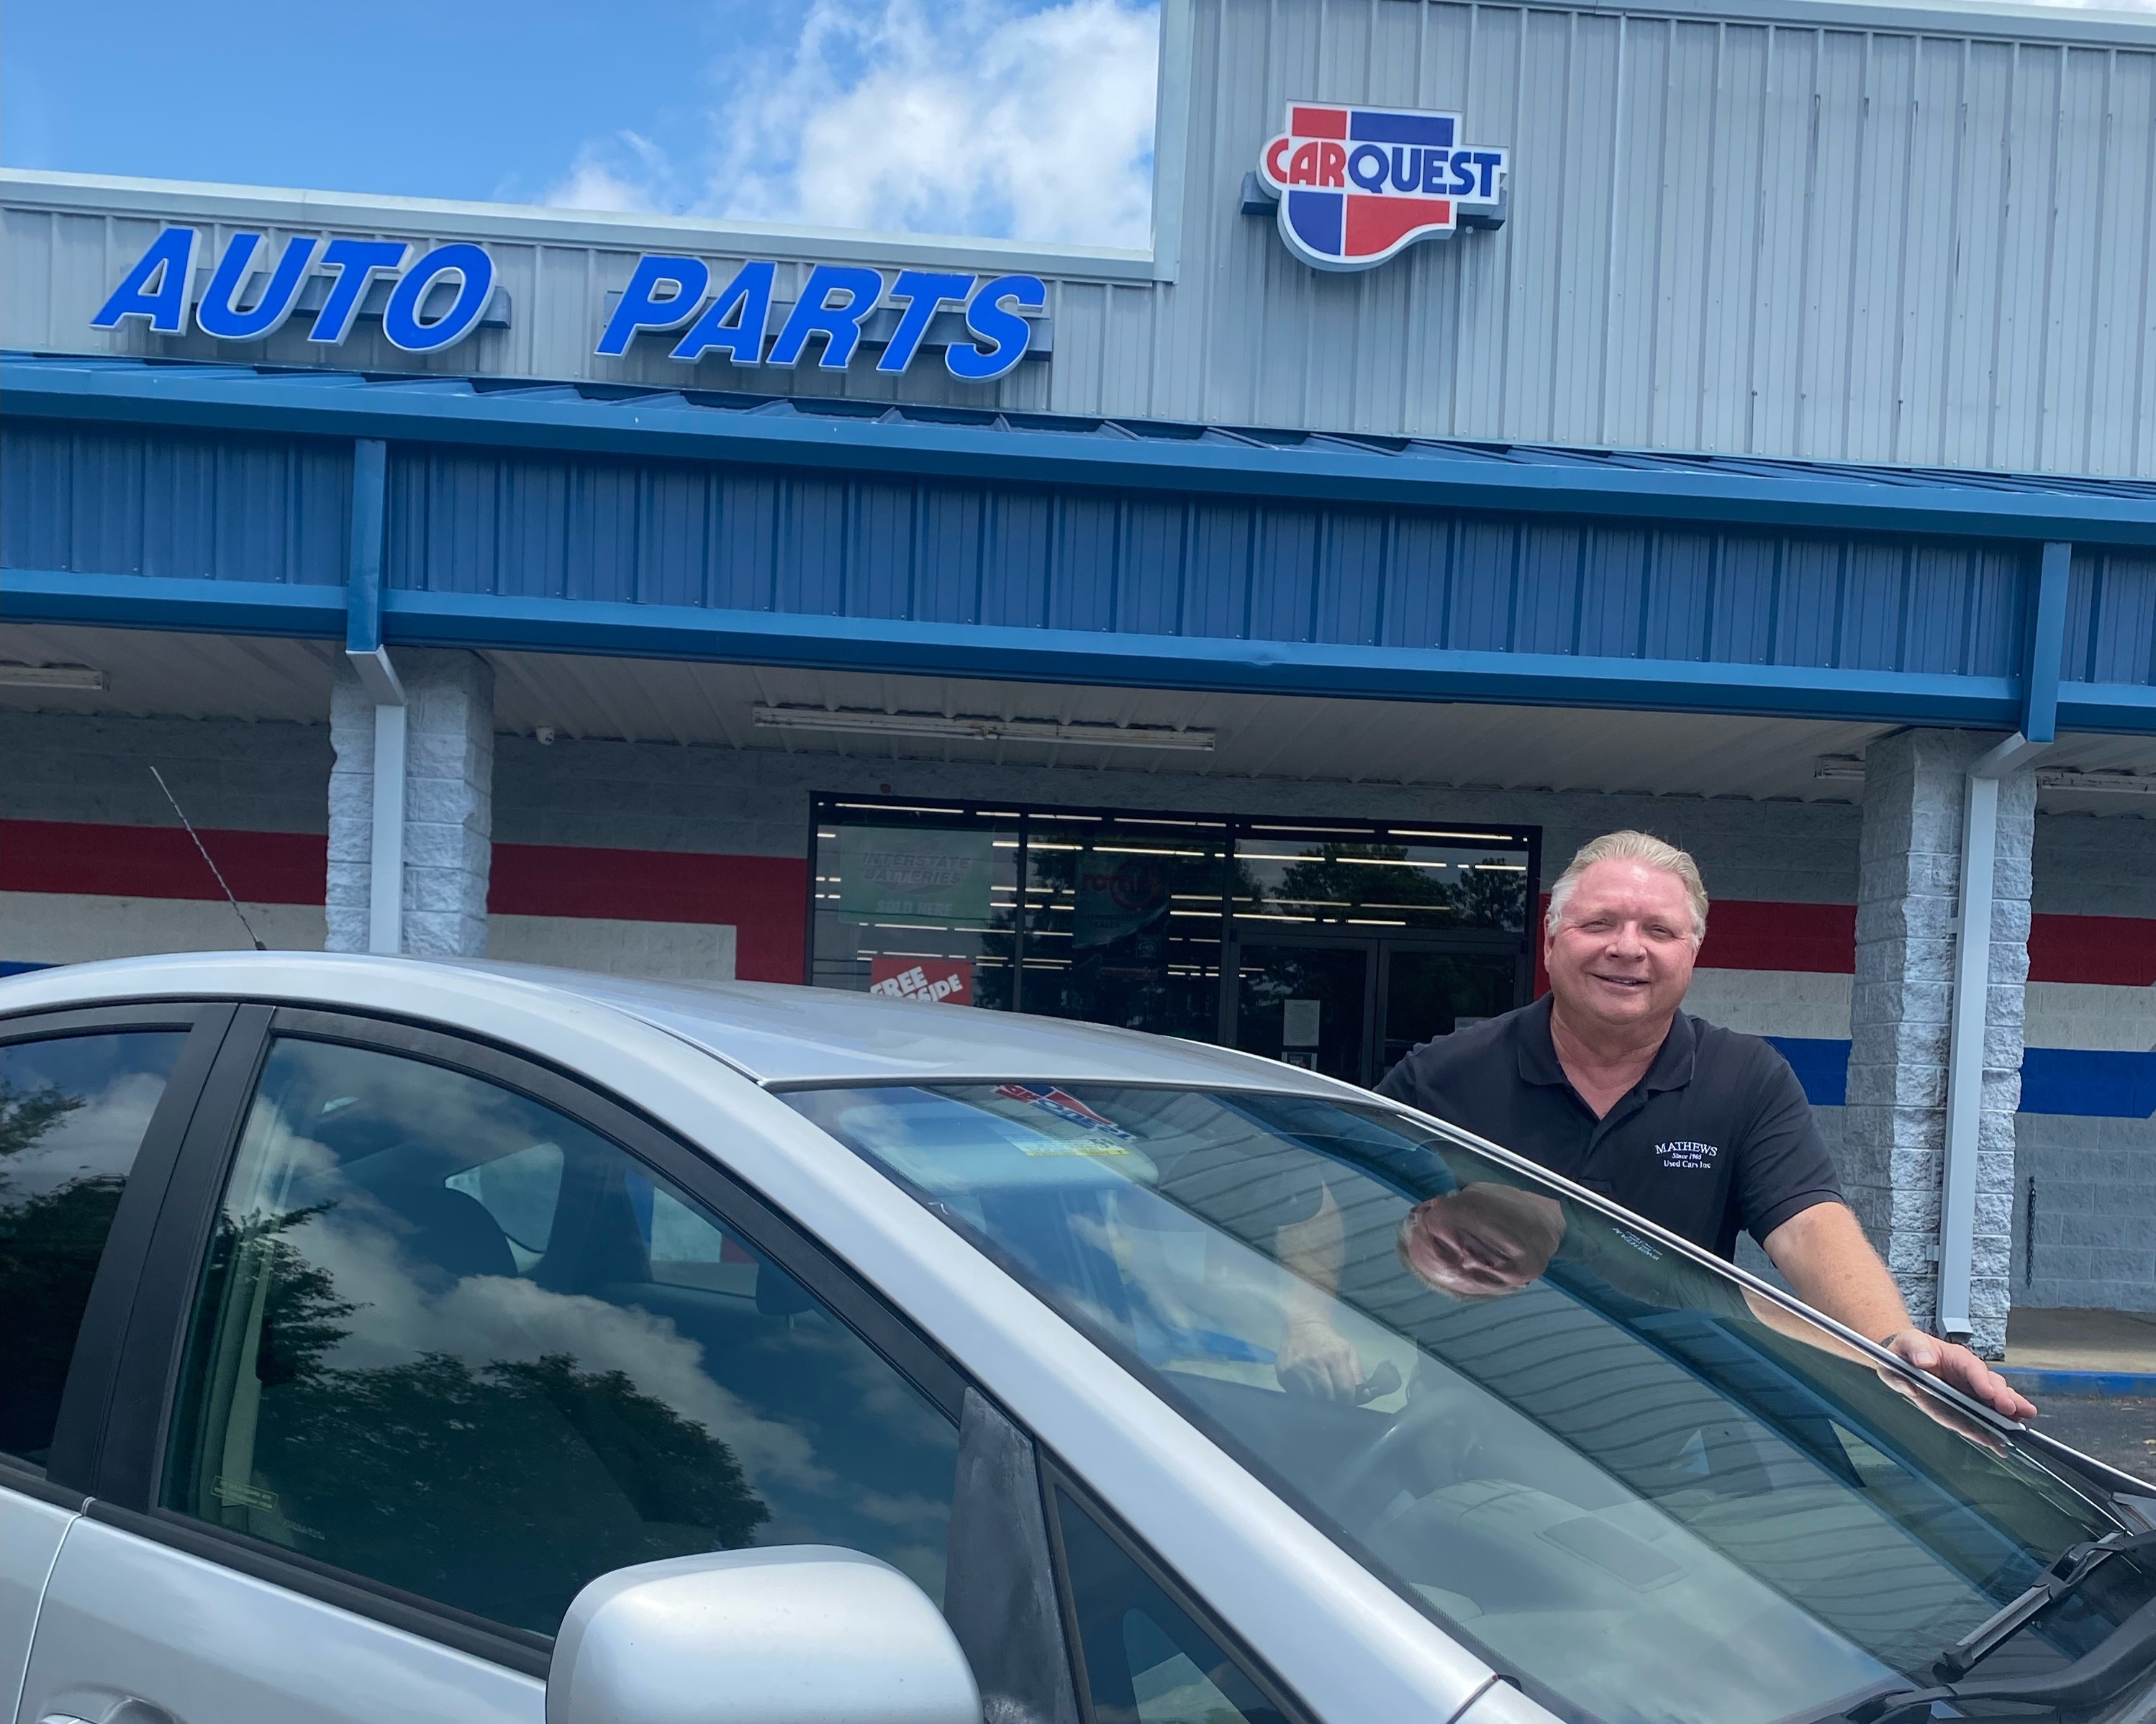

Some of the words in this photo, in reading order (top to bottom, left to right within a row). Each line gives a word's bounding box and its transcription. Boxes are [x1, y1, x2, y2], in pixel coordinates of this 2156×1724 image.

[1266, 137, 1502, 197] CARQUEST
[88, 225, 498, 354] AUTO
[593, 253, 1048, 384] PARTS
[863, 851, 971, 869] INTERSTATE
[863, 868, 962, 885] BATTERIES
[875, 901, 912, 914] SOLD
[917, 902, 954, 915] HERE
[870, 966, 928, 997] FREE
[903, 974, 963, 1002] SIDE
[1654, 1141, 1718, 1157] MATHEWS
[1682, 1160, 1699, 1169] Cars
